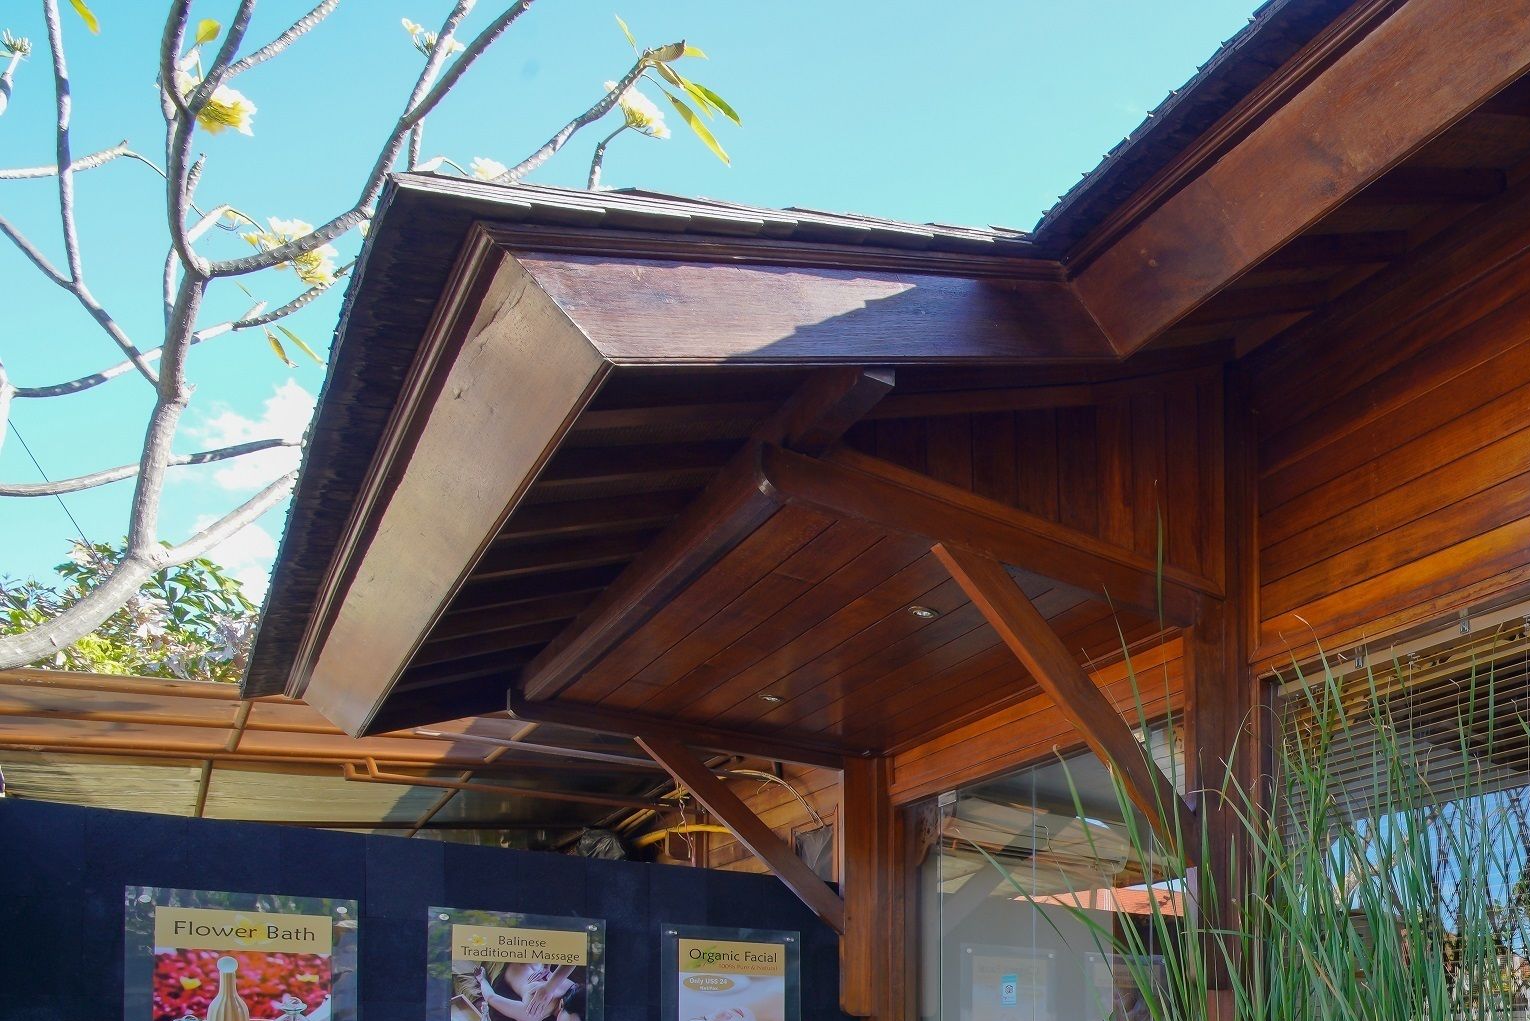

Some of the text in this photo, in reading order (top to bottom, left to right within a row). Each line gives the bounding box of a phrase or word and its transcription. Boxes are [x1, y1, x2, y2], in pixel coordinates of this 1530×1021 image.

[174, 920, 316, 941] Flower Bath
[498, 935, 547, 948] Balinese
[461, 946, 580, 963] Traditional Massage
[689, 948, 777, 963] Organic Facial
[689, 976, 704, 985] Only
